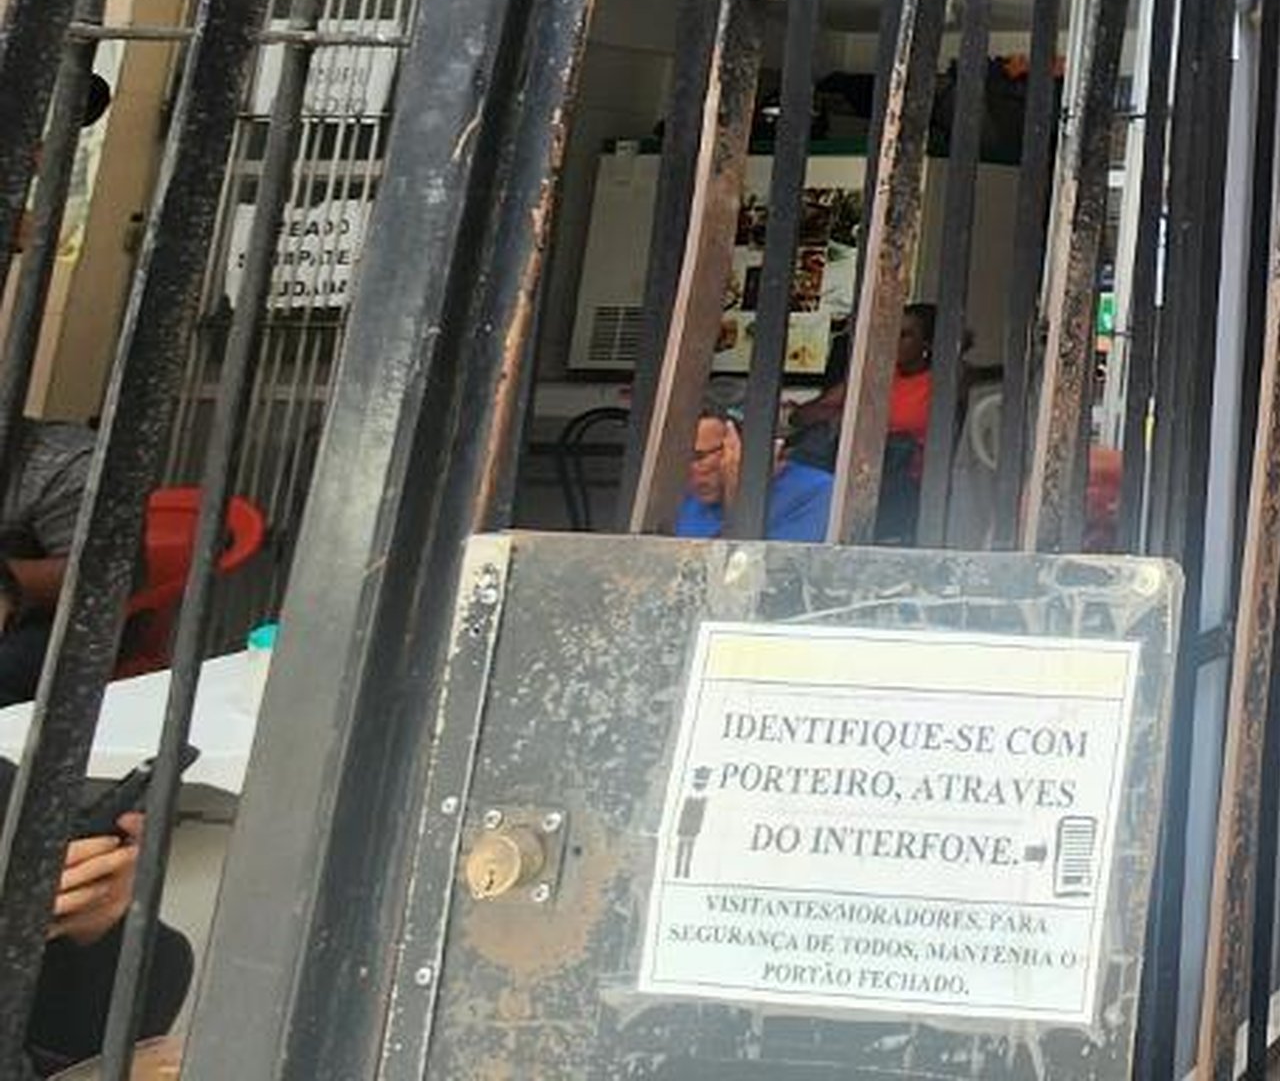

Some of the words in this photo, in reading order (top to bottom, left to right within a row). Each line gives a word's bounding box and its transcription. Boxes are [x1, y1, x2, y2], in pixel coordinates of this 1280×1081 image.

[722, 712, 995, 756] IDENTIFIQUE-SE
[1006, 725, 1088, 757] COM
[718, 762, 902, 806] PORTEIRO,
[749, 823, 802, 854] DO
[809, 825, 1020, 867] INTERFONE.
[989, 911, 1049, 935] PARA
[667, 923, 800, 953] SEGURANÇA
[805, 933, 835, 954] DE
[925, 942, 1054, 967] MANTENHA
[1060, 948, 1078, 968] O
[856, 968, 971, 996] FECHADO.
